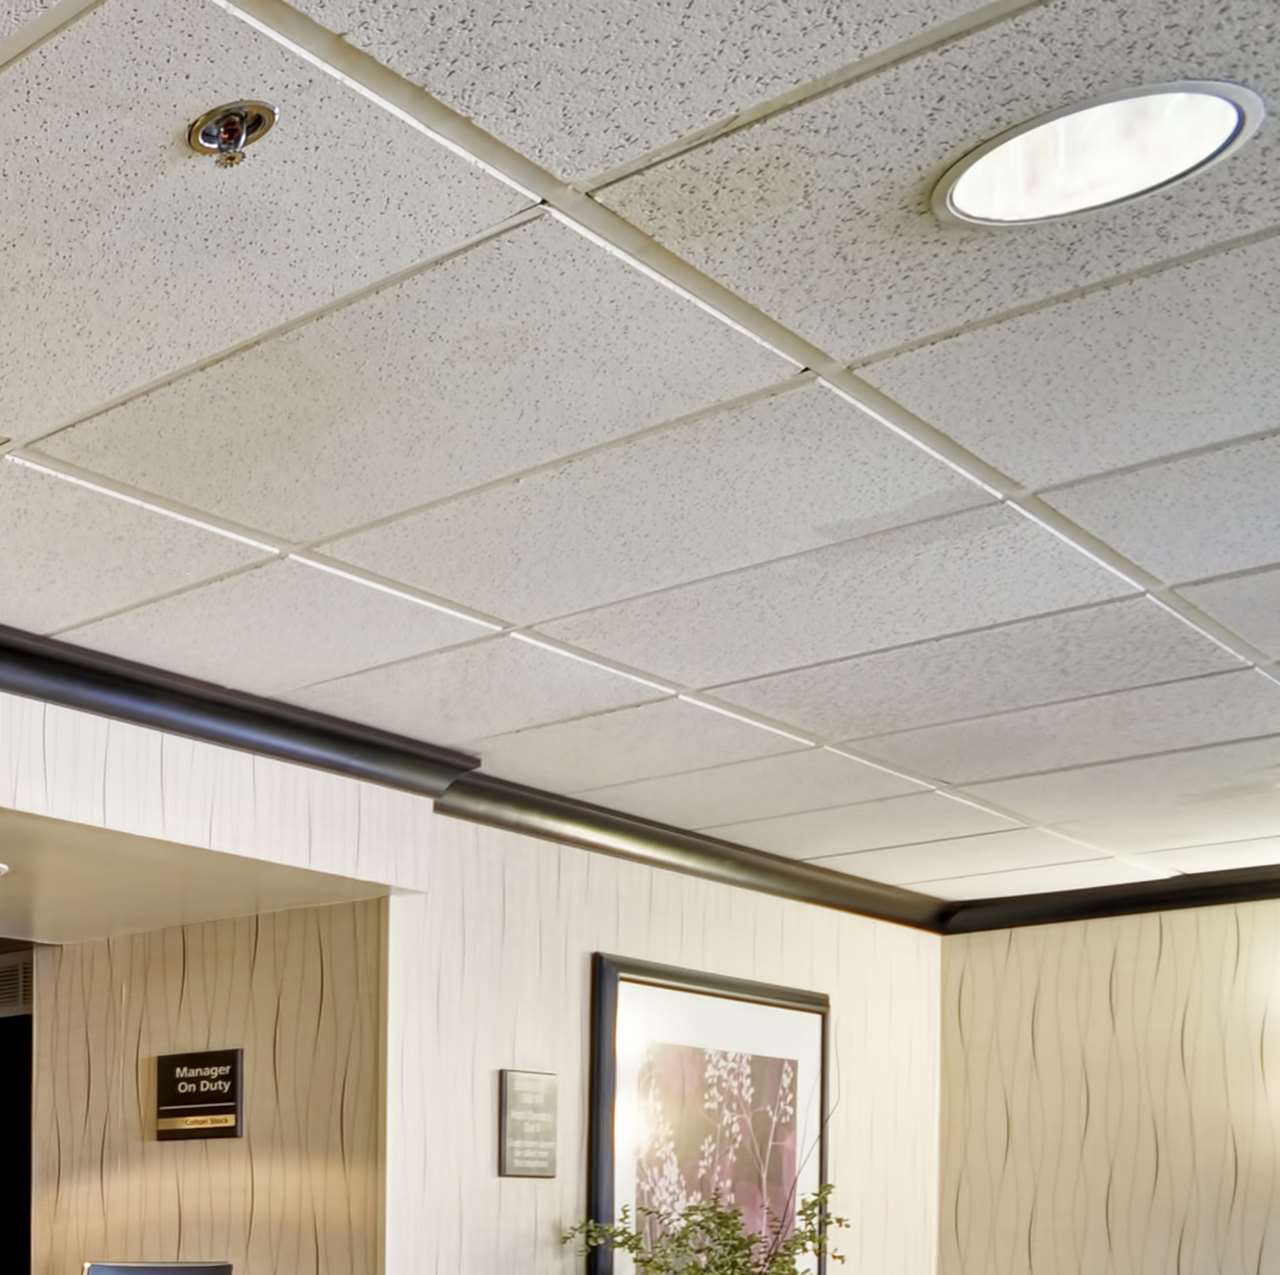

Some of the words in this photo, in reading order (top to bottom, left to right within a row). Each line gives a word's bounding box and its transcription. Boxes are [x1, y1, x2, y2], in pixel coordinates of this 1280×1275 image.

[175, 1065, 232, 1079] Manager
[177, 1082, 196, 1093] On
[200, 1080, 232, 1093] Duty
